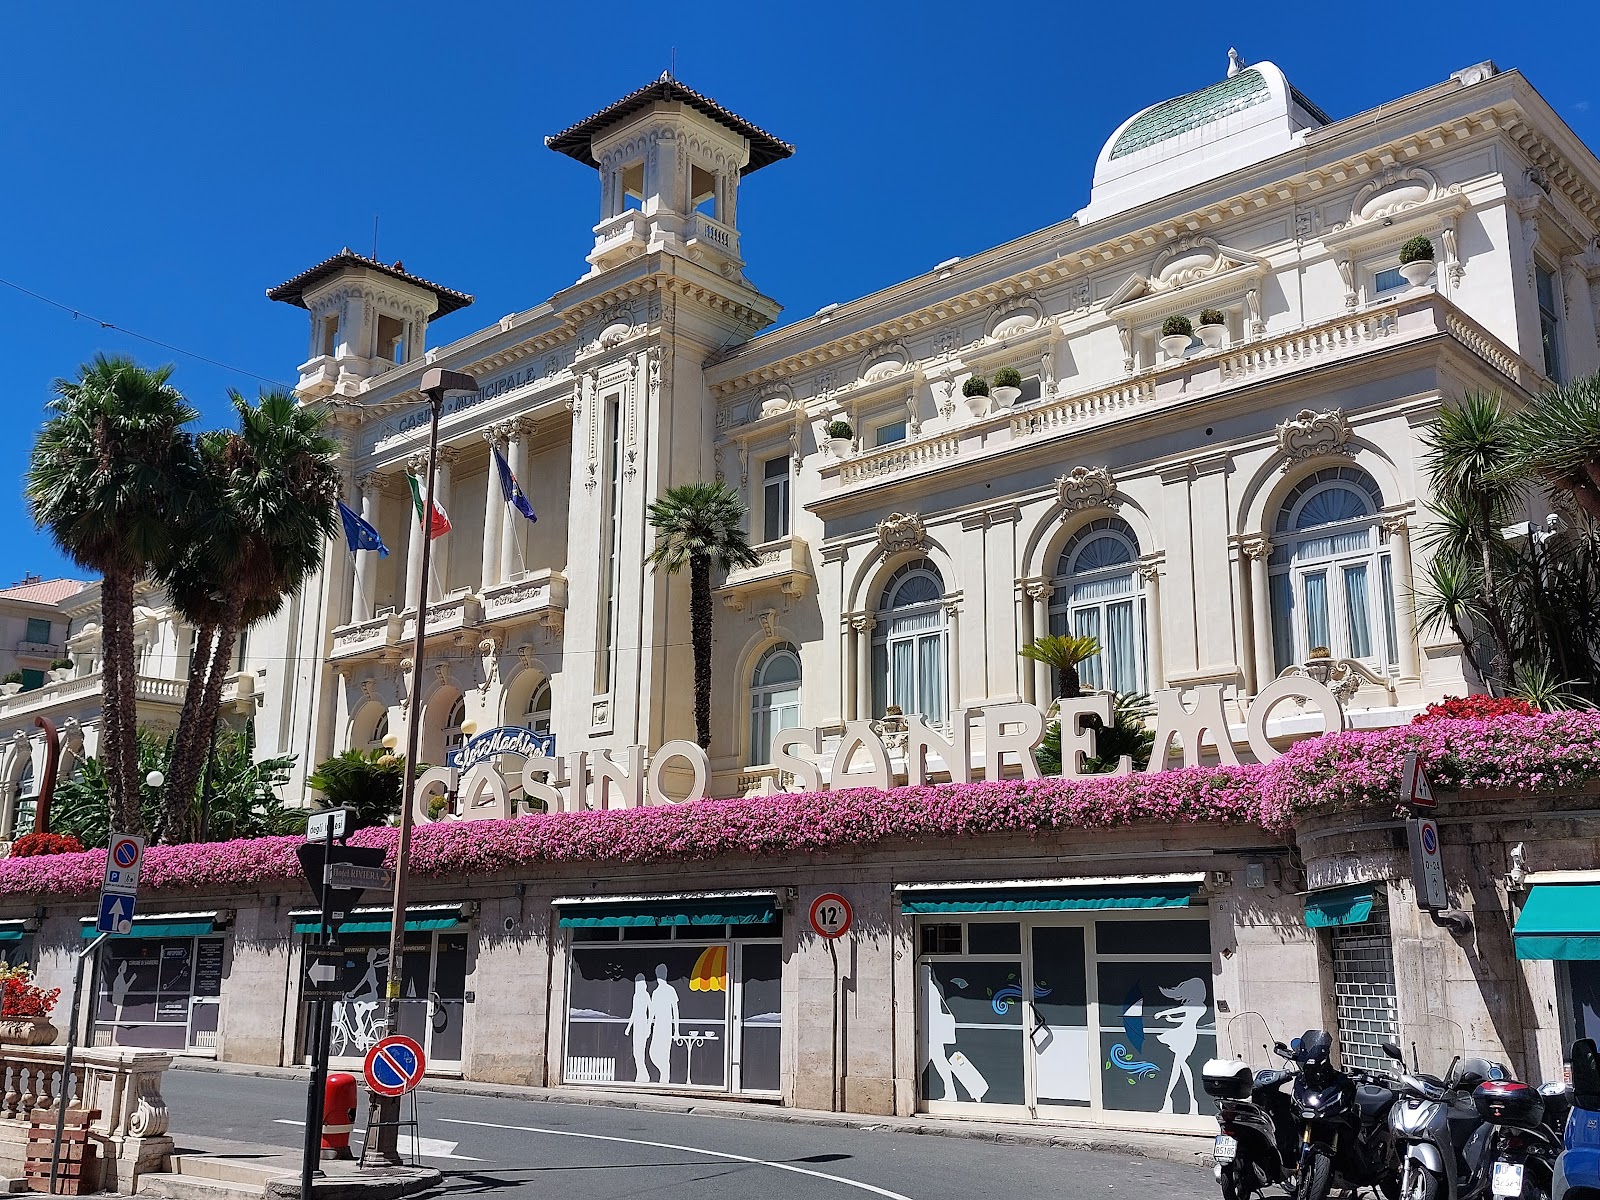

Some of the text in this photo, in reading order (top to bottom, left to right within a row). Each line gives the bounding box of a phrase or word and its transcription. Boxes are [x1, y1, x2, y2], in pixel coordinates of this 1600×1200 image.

[411, 675, 1346, 828] CASINO SANREMO
[310, 822, 324, 834] degli
[350, 868, 379, 879] RIVIERA
